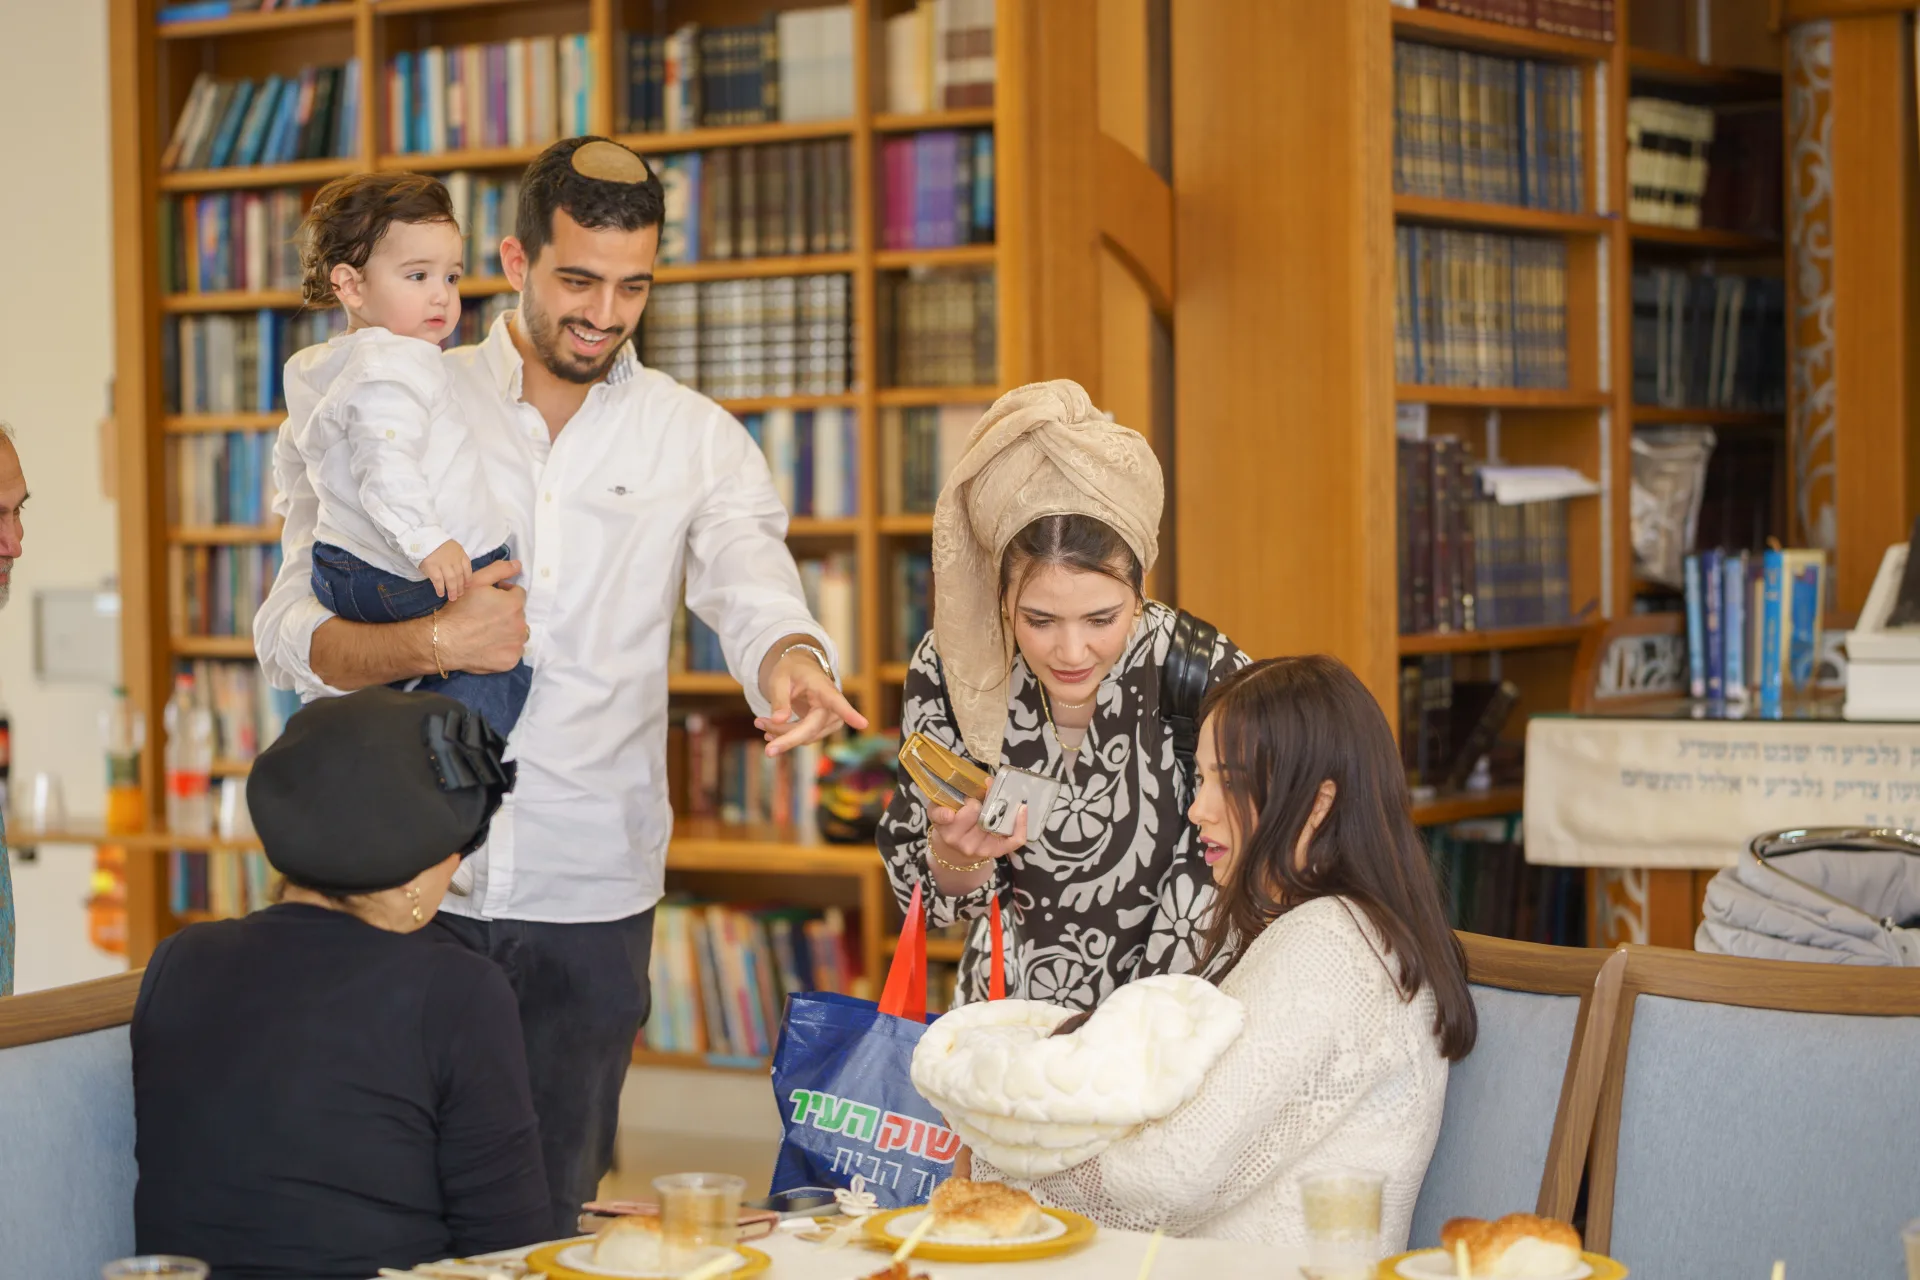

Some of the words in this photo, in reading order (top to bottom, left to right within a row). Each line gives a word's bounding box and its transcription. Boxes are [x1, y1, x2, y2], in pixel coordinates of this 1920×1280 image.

[789, 1088, 881, 1143] העיר
[874, 1110, 964, 1164] שוק
[830, 1146, 903, 1190] הבית
